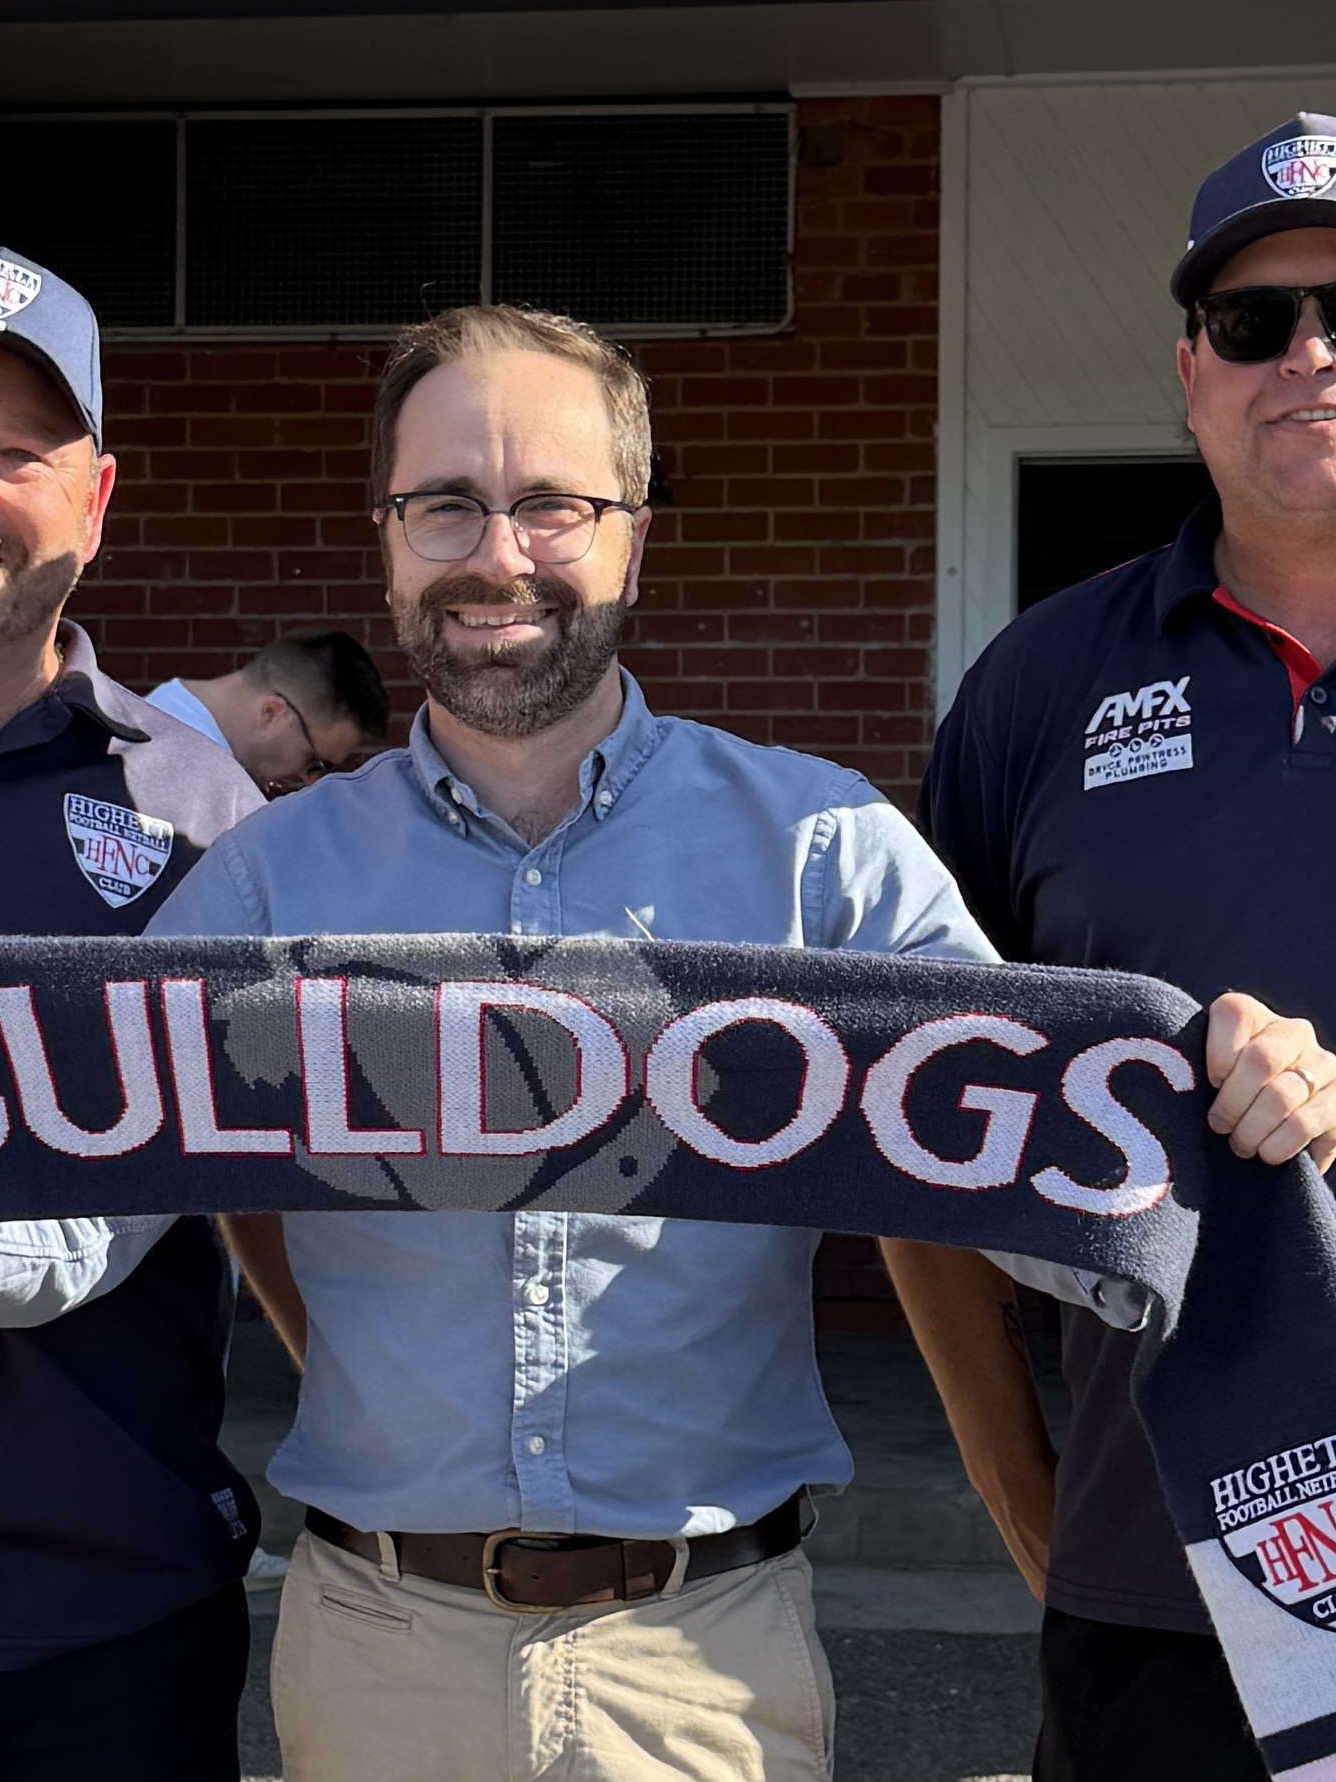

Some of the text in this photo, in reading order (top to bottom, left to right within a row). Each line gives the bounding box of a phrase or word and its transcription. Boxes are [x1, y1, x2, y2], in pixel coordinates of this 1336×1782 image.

[1084, 715, 1191, 750] FIRE PITS
[69, 796, 171, 839] HIGHETT
[85, 834, 150, 880] HFNC
[1216, 1486, 1298, 1532] FOOTBALL
